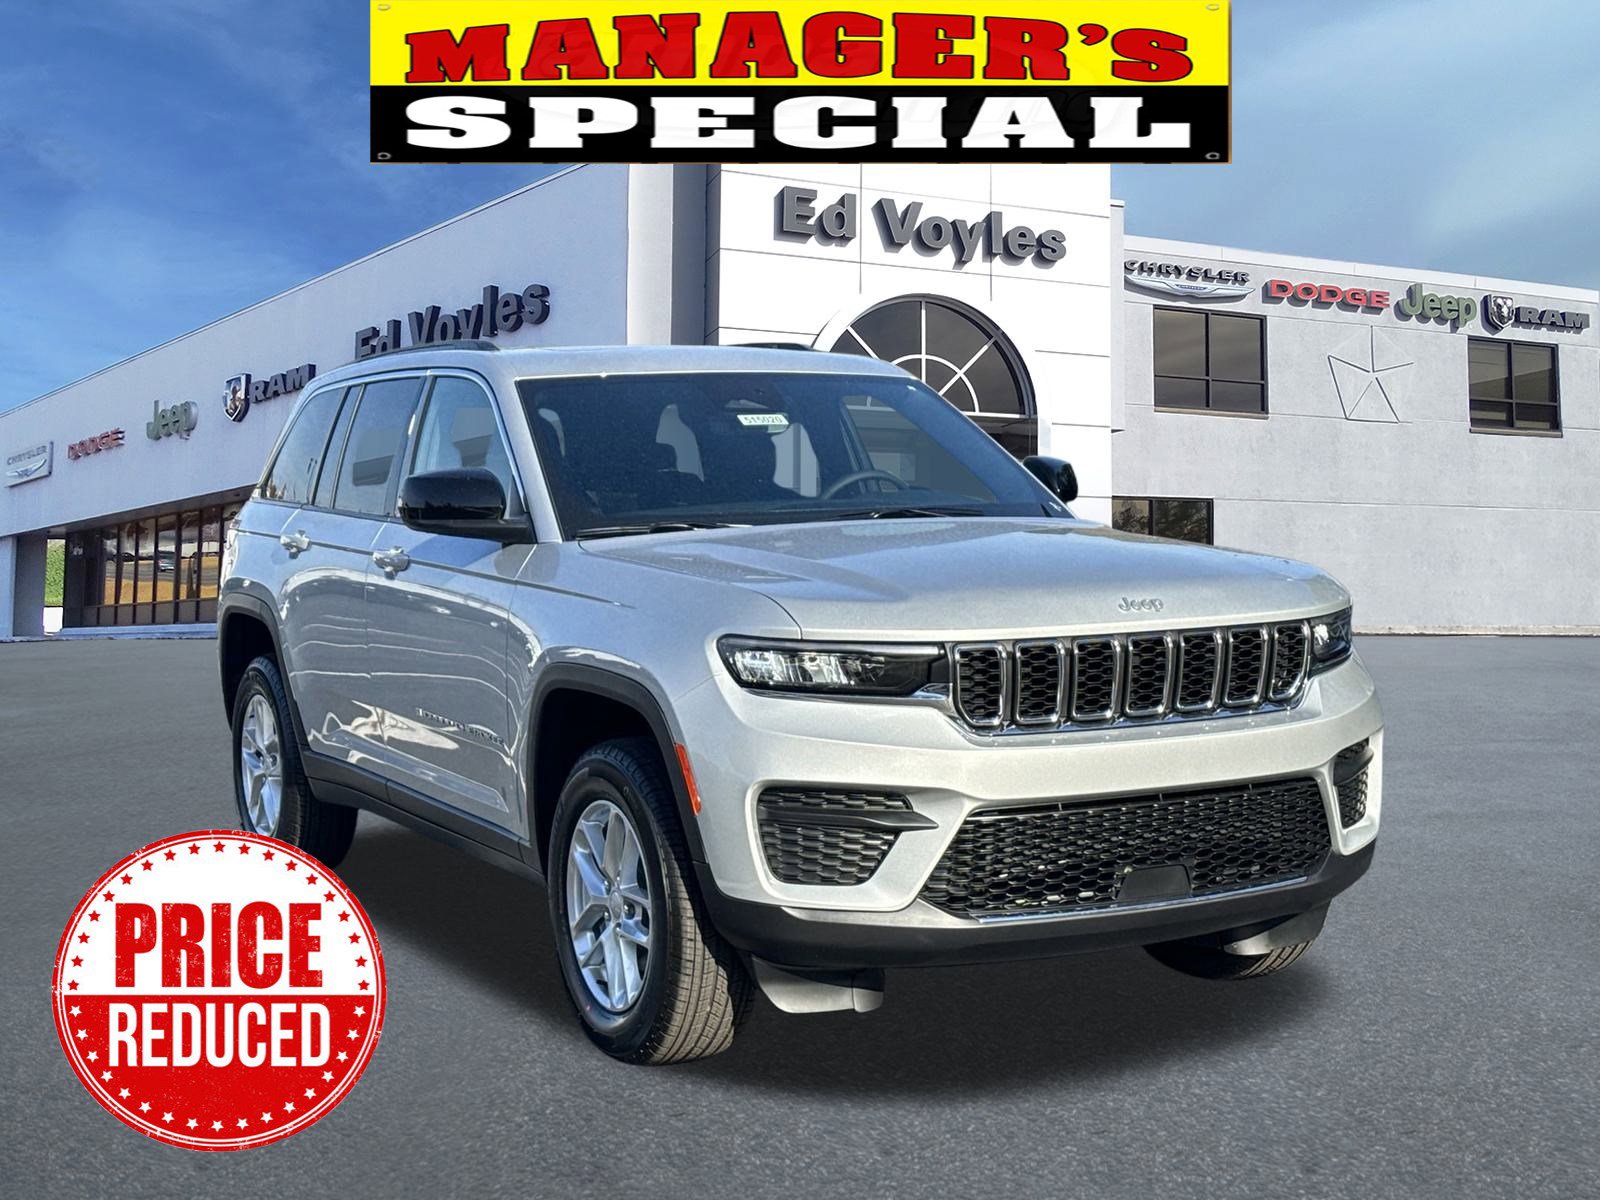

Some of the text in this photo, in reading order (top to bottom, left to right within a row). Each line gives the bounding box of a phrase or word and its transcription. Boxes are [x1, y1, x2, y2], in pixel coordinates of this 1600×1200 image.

[774, 186, 1067, 270] Ed Voyles
[1124, 259, 1252, 286] CHRYSLER
[1262, 279, 1391, 315] DODGE
[1394, 283, 1477, 333] Jeep
[354, 283, 551, 359] Ed Voyles
[1513, 306, 1591, 334] RAM
[250, 363, 317, 404] RAM
[146, 400, 199, 441] Jeep
[67, 427, 126, 461] DODGE
[1118, 597, 1164, 613] Jeep
